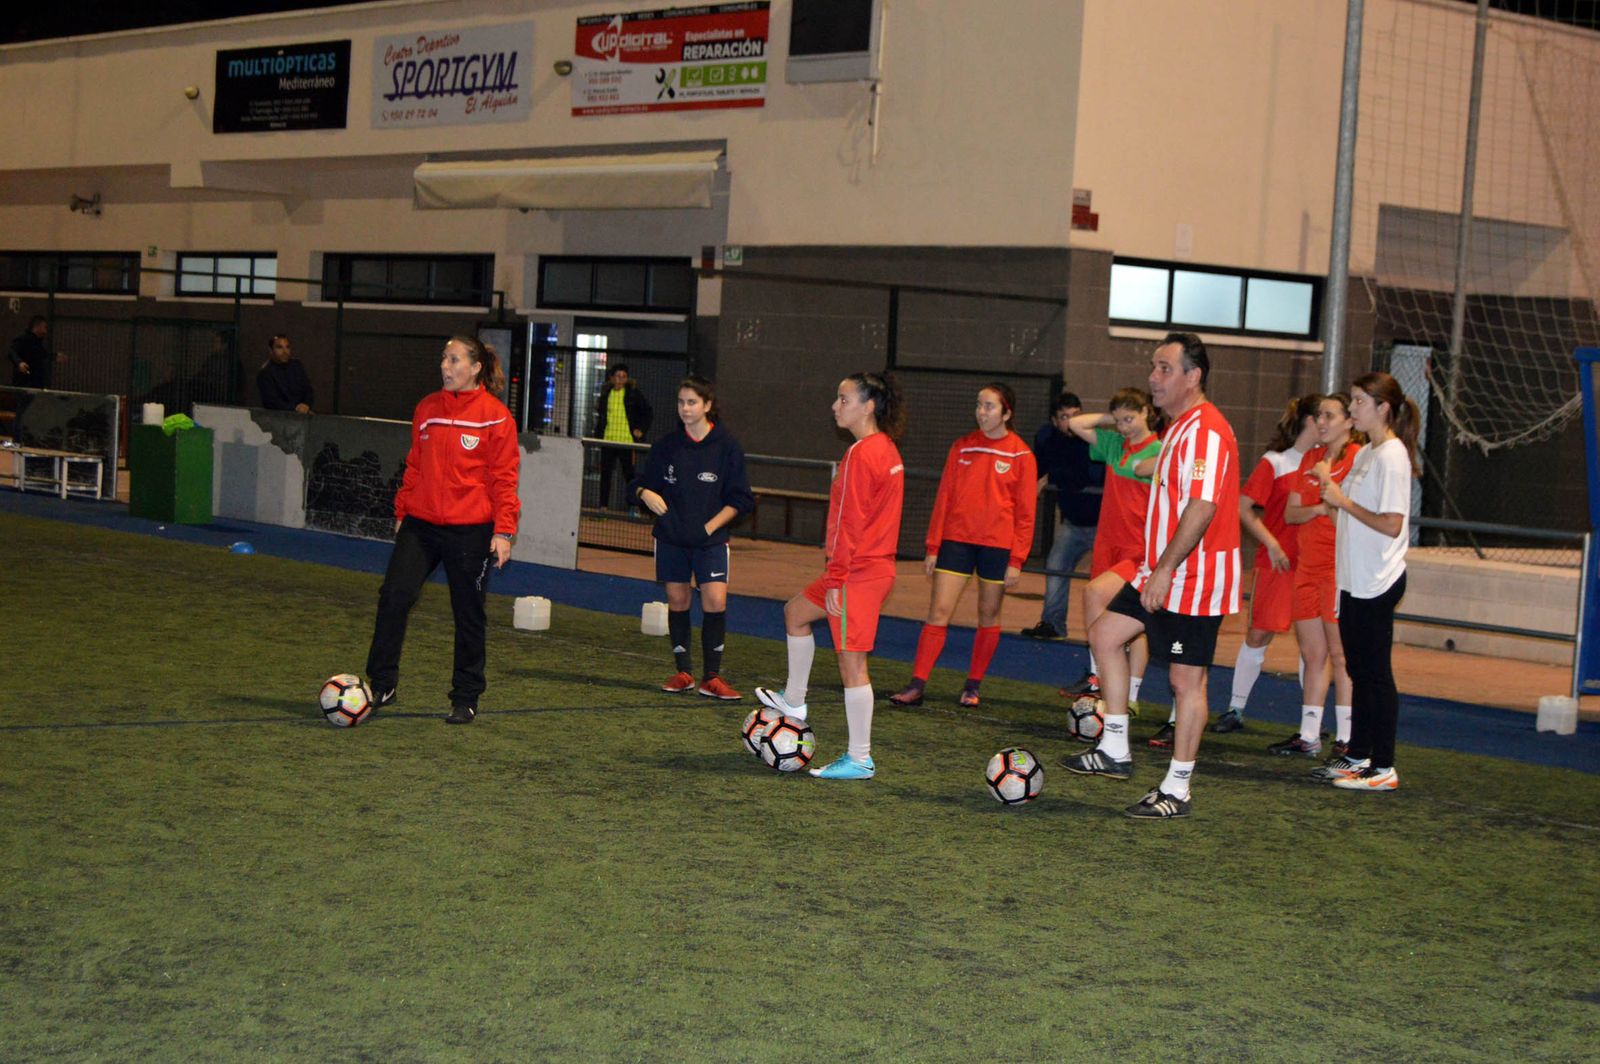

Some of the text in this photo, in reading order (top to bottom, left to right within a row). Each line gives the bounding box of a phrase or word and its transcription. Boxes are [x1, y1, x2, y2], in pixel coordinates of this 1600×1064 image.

[735, 27, 745, 38] en
[384, 45, 413, 66] Centro
[683, 37, 762, 60] REPARACIÓN
[279, 75, 335, 90] Mediterráneo
[383, 51, 519, 102] SPORTGYM
[465, 96, 478, 114] El
